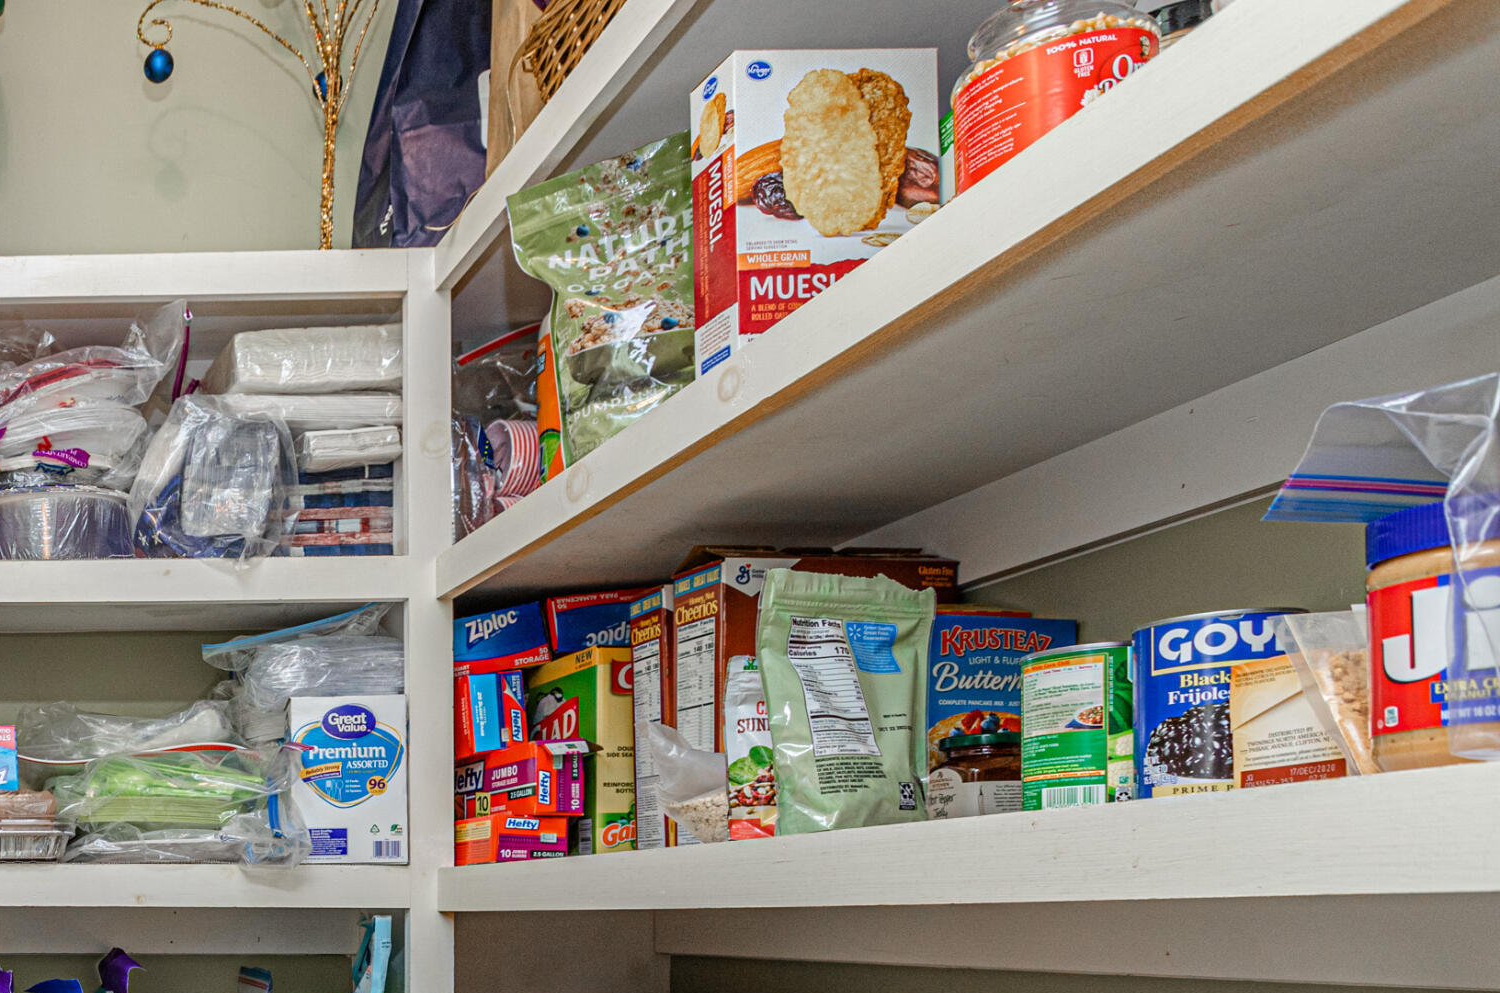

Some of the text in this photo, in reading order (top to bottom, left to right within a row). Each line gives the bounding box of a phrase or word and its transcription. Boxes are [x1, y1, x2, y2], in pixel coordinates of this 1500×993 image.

[1046, 34, 1118, 56] 100% NATURAL
[708, 159, 723, 247] MUESLI
[589, 230, 690, 281] PATH
[747, 252, 808, 264] WHOLE GRAIN
[750, 273, 836, 301] MUES
[674, 599, 718, 626] Cheerios
[465, 610, 518, 644] Ziploc
[791, 618, 842, 629] Nutrition Facts
[1381, 576, 1500, 684] Ji
[631, 624, 661, 646] Cheerios
[940, 625, 1053, 656] KRUSTEAZ
[514, 653, 549, 666] STORAGE
[575, 650, 593, 664] NEW
[969, 656, 1000, 665] LIGHT &
[1179, 670, 1231, 688] Black
[328, 712, 367, 732] Great Value
[511, 711, 522, 741] Hefty
[308, 742, 386, 760] Premium
[346, 760, 389, 769] ASSORTED
[491, 765, 518, 781] JUMBO
[368, 778, 386, 789] 96
[539, 773, 550, 802] Hefty
[1172, 785, 1219, 795] PRIME
[477, 795, 489, 811] 10
[571, 800, 580, 810] 10
[507, 819, 538, 829] Hefty
[602, 821, 636, 848] Gai
[500, 849, 511, 858] 10
